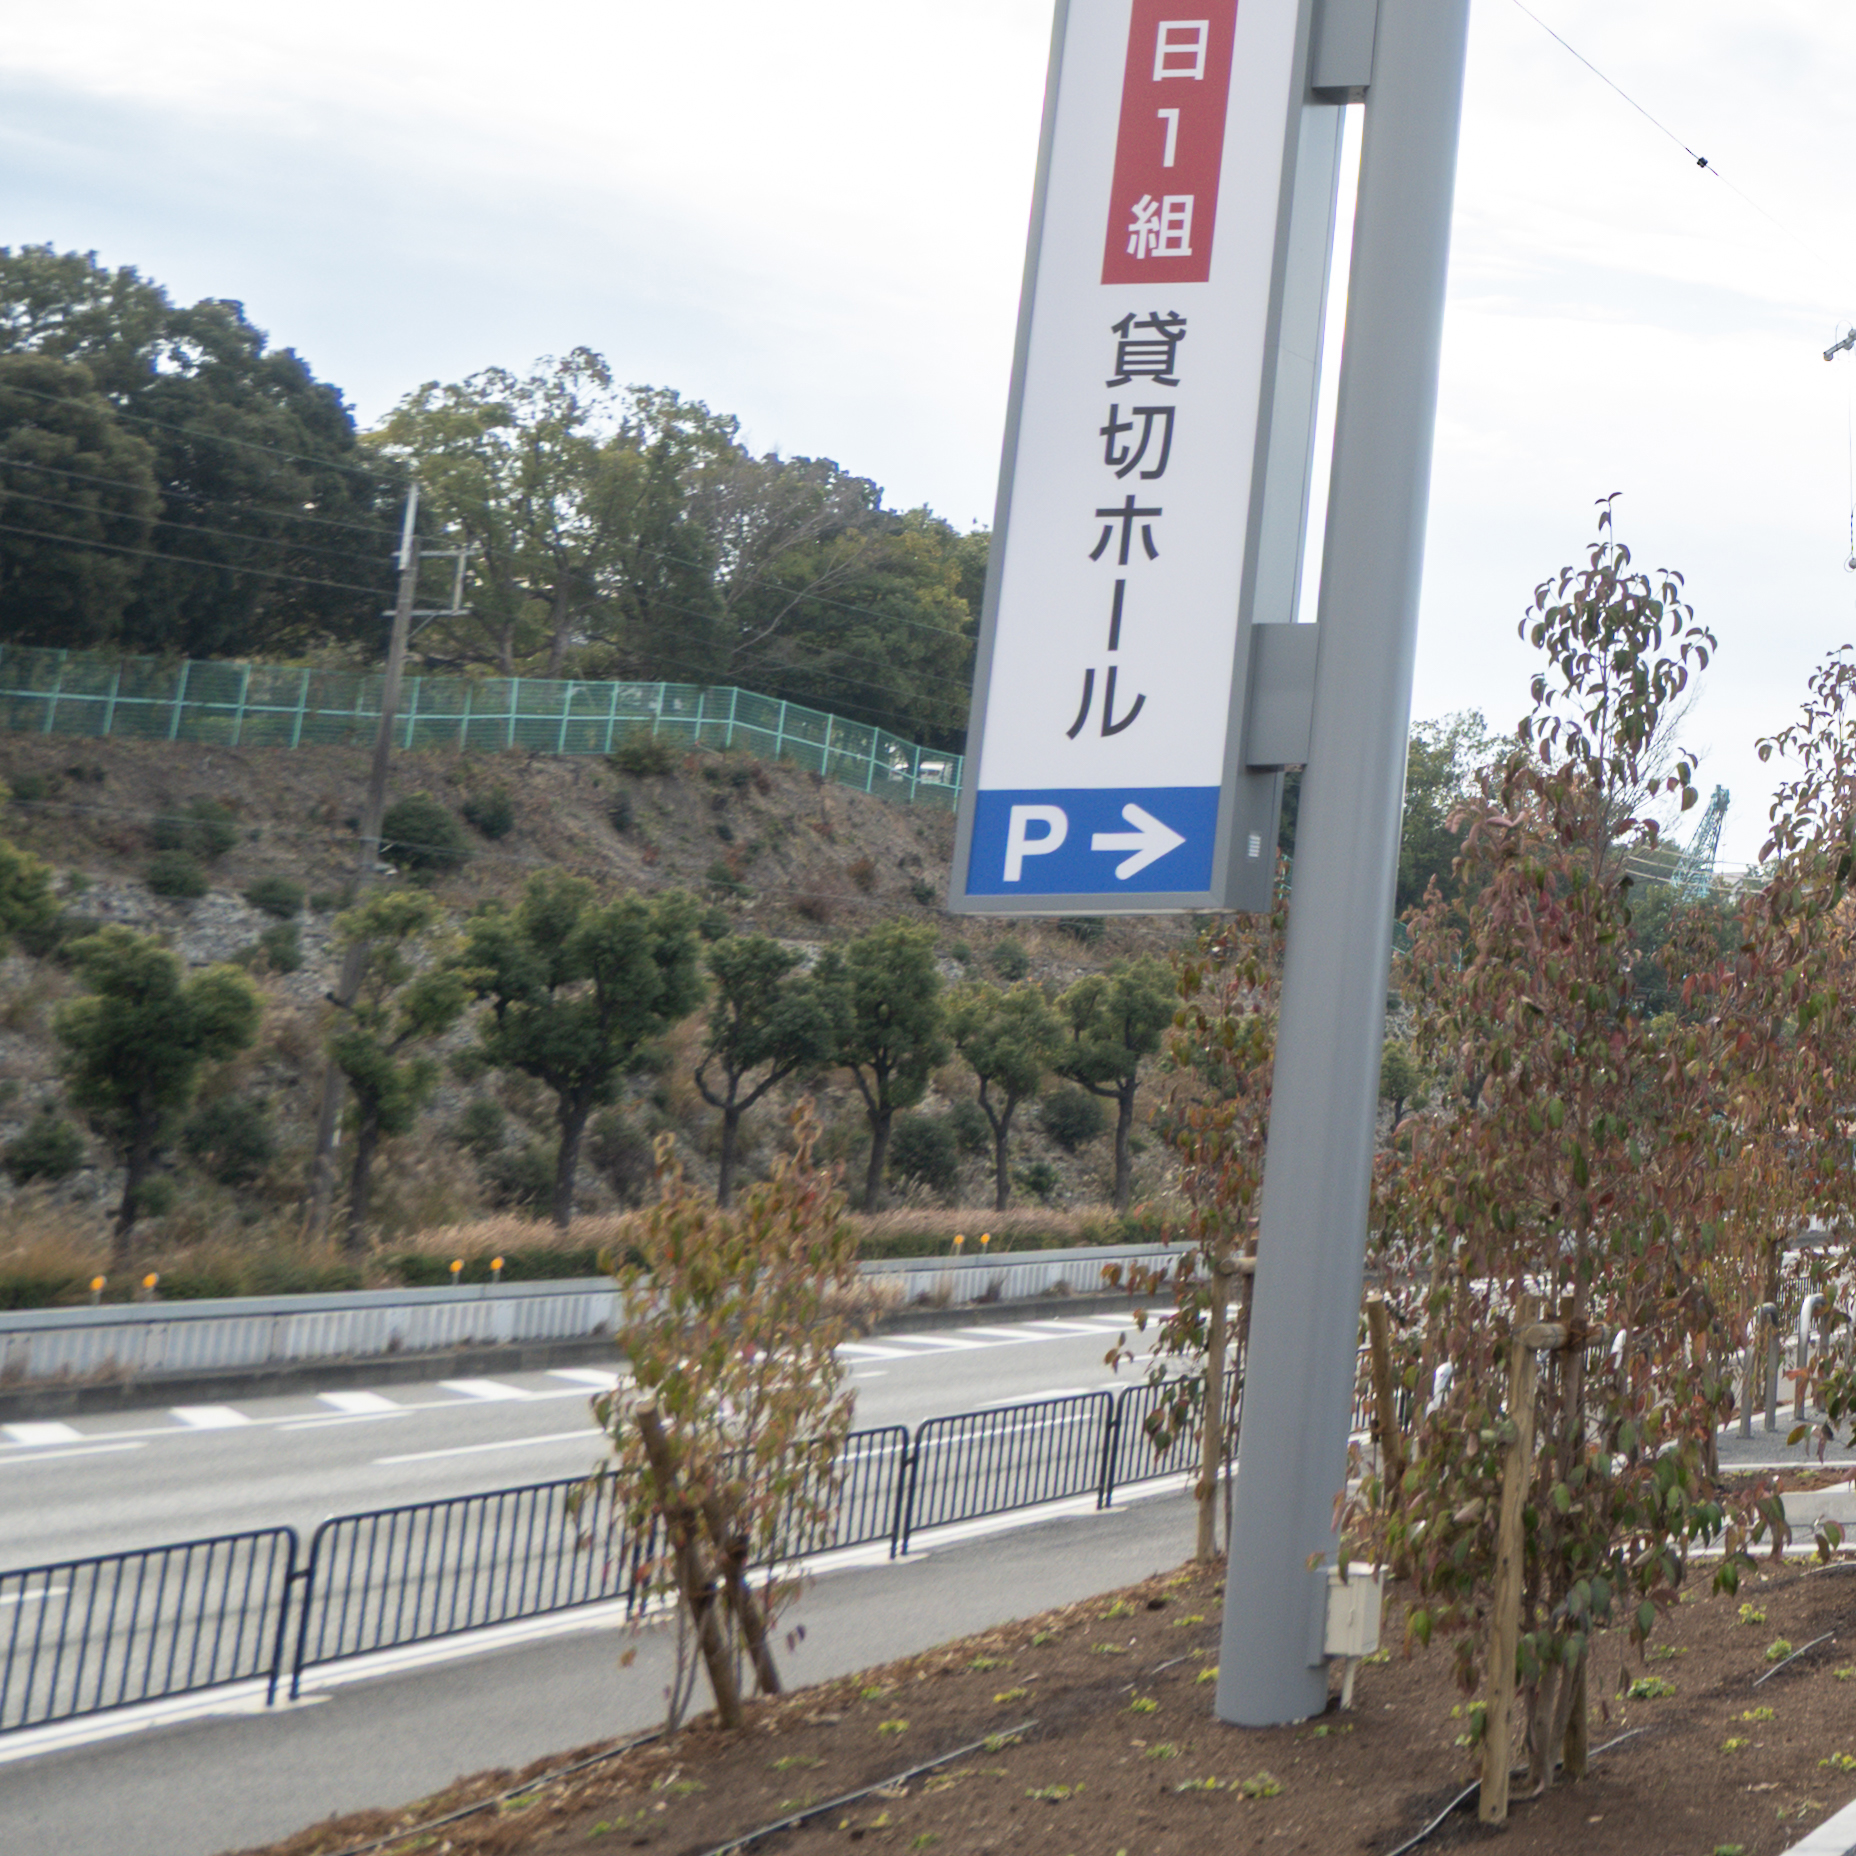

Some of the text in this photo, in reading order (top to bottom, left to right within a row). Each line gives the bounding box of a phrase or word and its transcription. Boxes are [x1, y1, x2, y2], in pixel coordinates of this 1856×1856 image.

[1066, 310, 1187, 740] 貸切ホール
[1003, 804, 1069, 882] P
